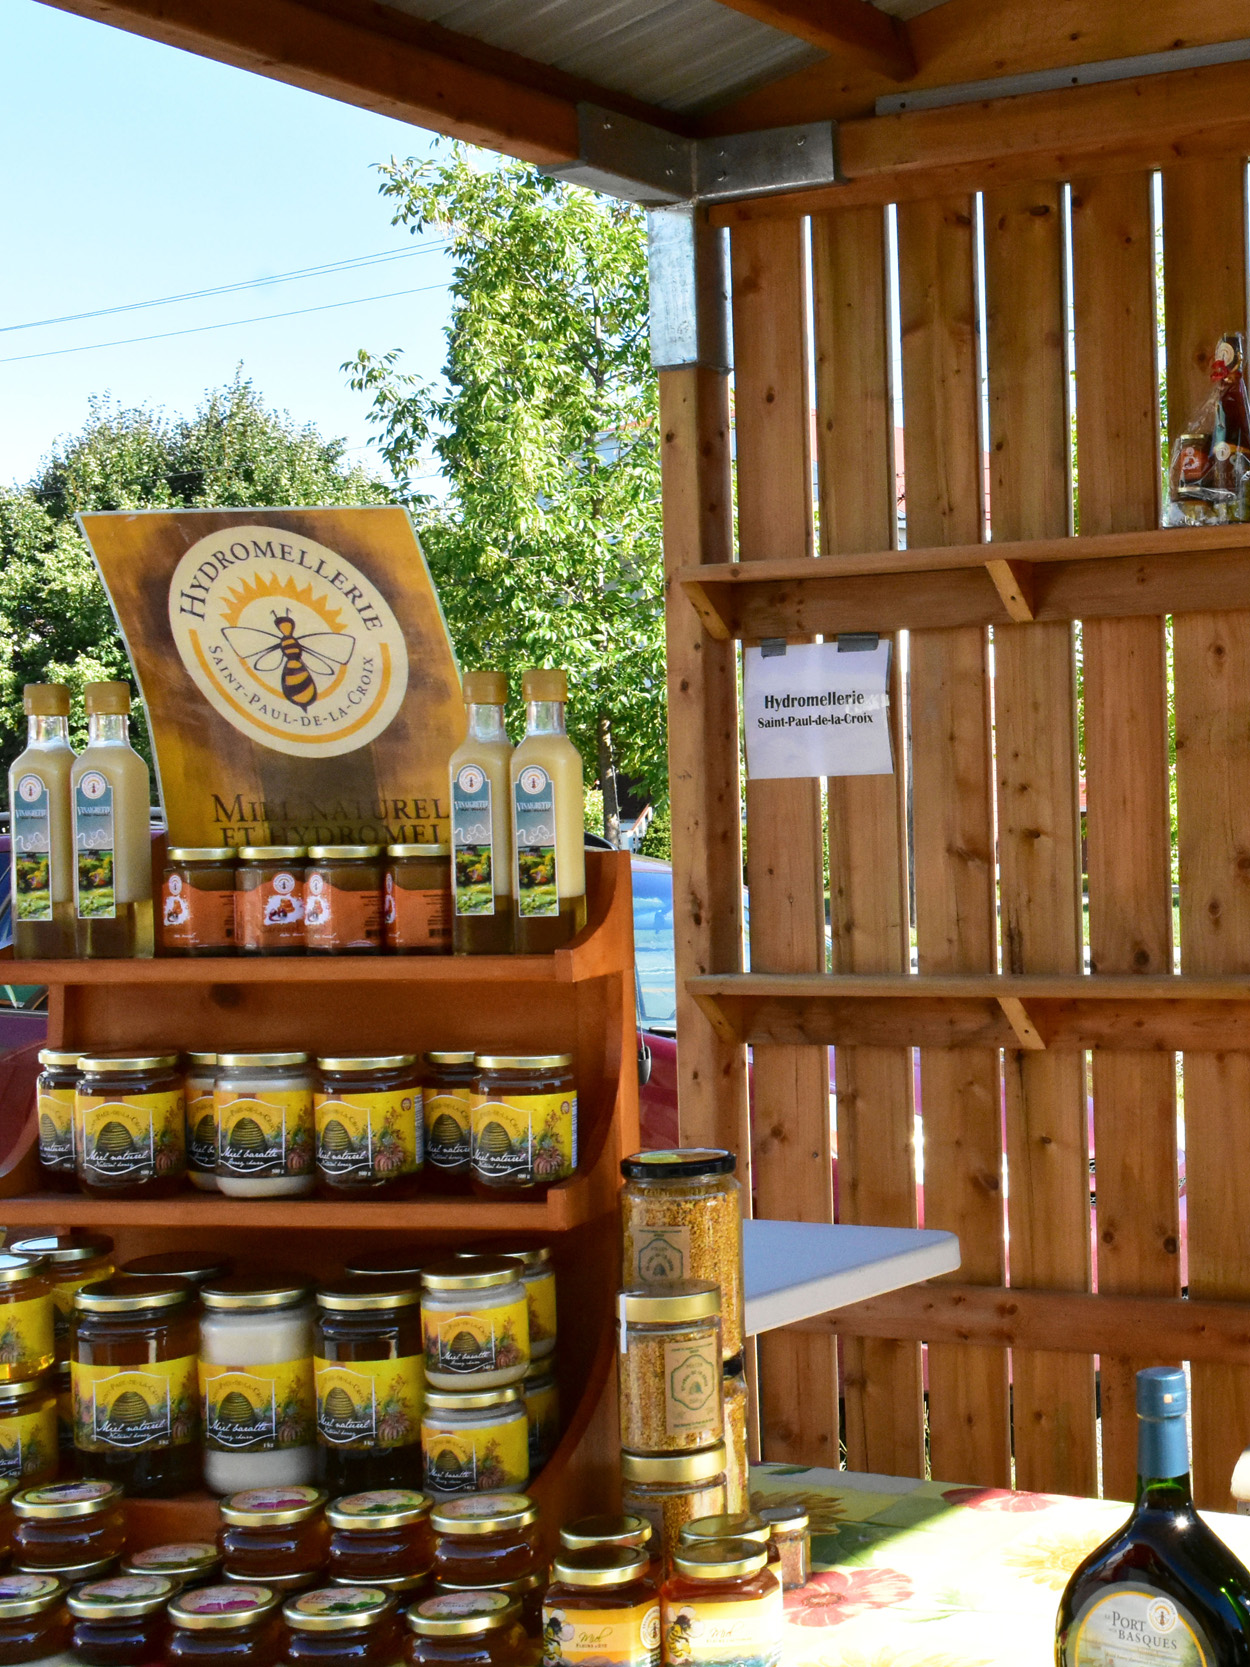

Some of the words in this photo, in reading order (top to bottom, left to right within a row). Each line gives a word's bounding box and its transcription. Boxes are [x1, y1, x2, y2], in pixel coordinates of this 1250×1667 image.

[180, 540, 384, 631] HYDROMELLERIE
[208, 645, 375, 727] SAINT-PAUL-DE-LA-CROIX
[764, 691, 865, 711] Hydromellerie
[757, 713, 874, 729] Saint-Paul-de-la-Croix
[309, 798, 450, 821] NATUREL
[219, 826, 257, 847] ET
[86, 1149, 110, 1161] Miel
[110, 1151, 149, 1161] naturel
[220, 1146, 242, 1158] Miel
[331, 1150, 367, 1160] naturel
[442, 1143, 470, 1153] nature
[490, 1152, 527, 1162] naturel
[96, 1420, 125, 1432] Miel
[126, 1419, 166, 1432] naturel
[208, 1419, 232, 1431] Miel
[335, 1418, 371, 1429] naturel
[1111, 1611, 1147, 1632] PORT
[579, 1626, 613, 1643] Miel
[1118, 1629, 1178, 1650] BASQUES
